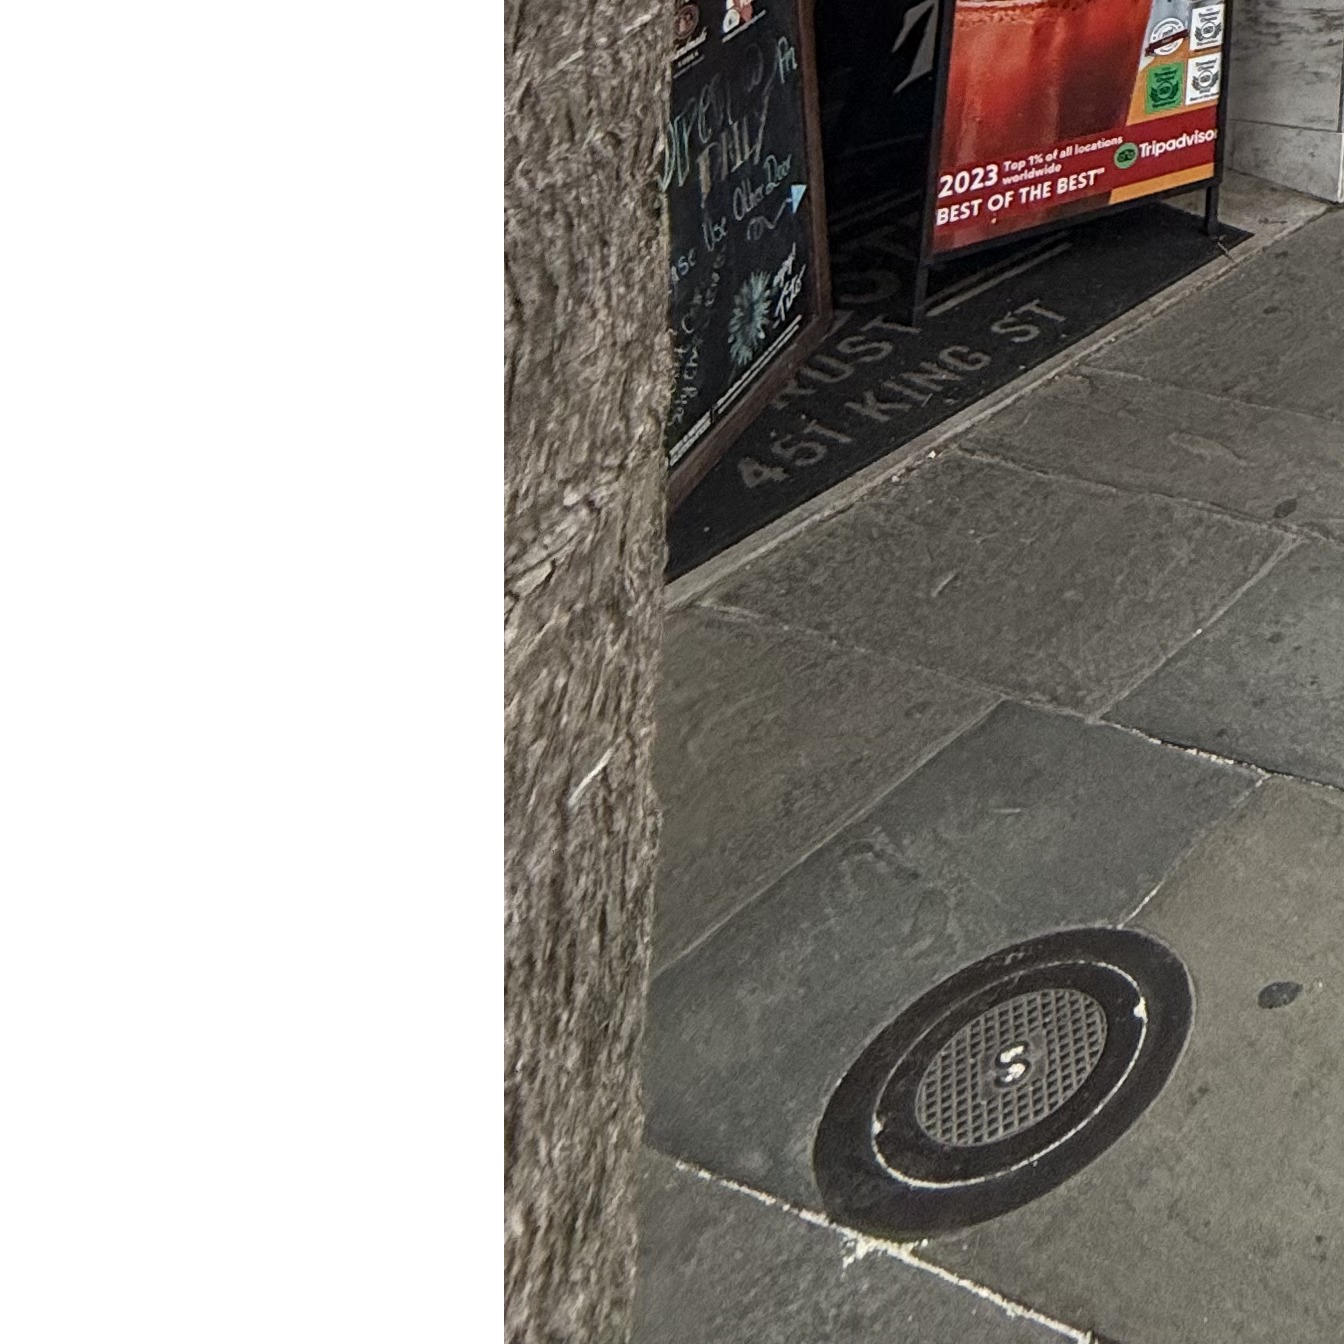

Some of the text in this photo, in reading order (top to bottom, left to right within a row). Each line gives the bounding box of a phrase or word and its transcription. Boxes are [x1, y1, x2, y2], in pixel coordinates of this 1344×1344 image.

[1002, 162, 1062, 186] worldwide
[1004, 135, 1123, 172] Top 1% of all locations
[937, 164, 999, 199] 2023
[936, 199, 983, 226] BEST
[987, 191, 1015, 212] OF
[1018, 181, 1052, 204] THE
[737, 418, 852, 490] 451
[845, 344, 993, 423] KING
[990, 298, 1066, 343] ST
[993, 1041, 1033, 1088] S
